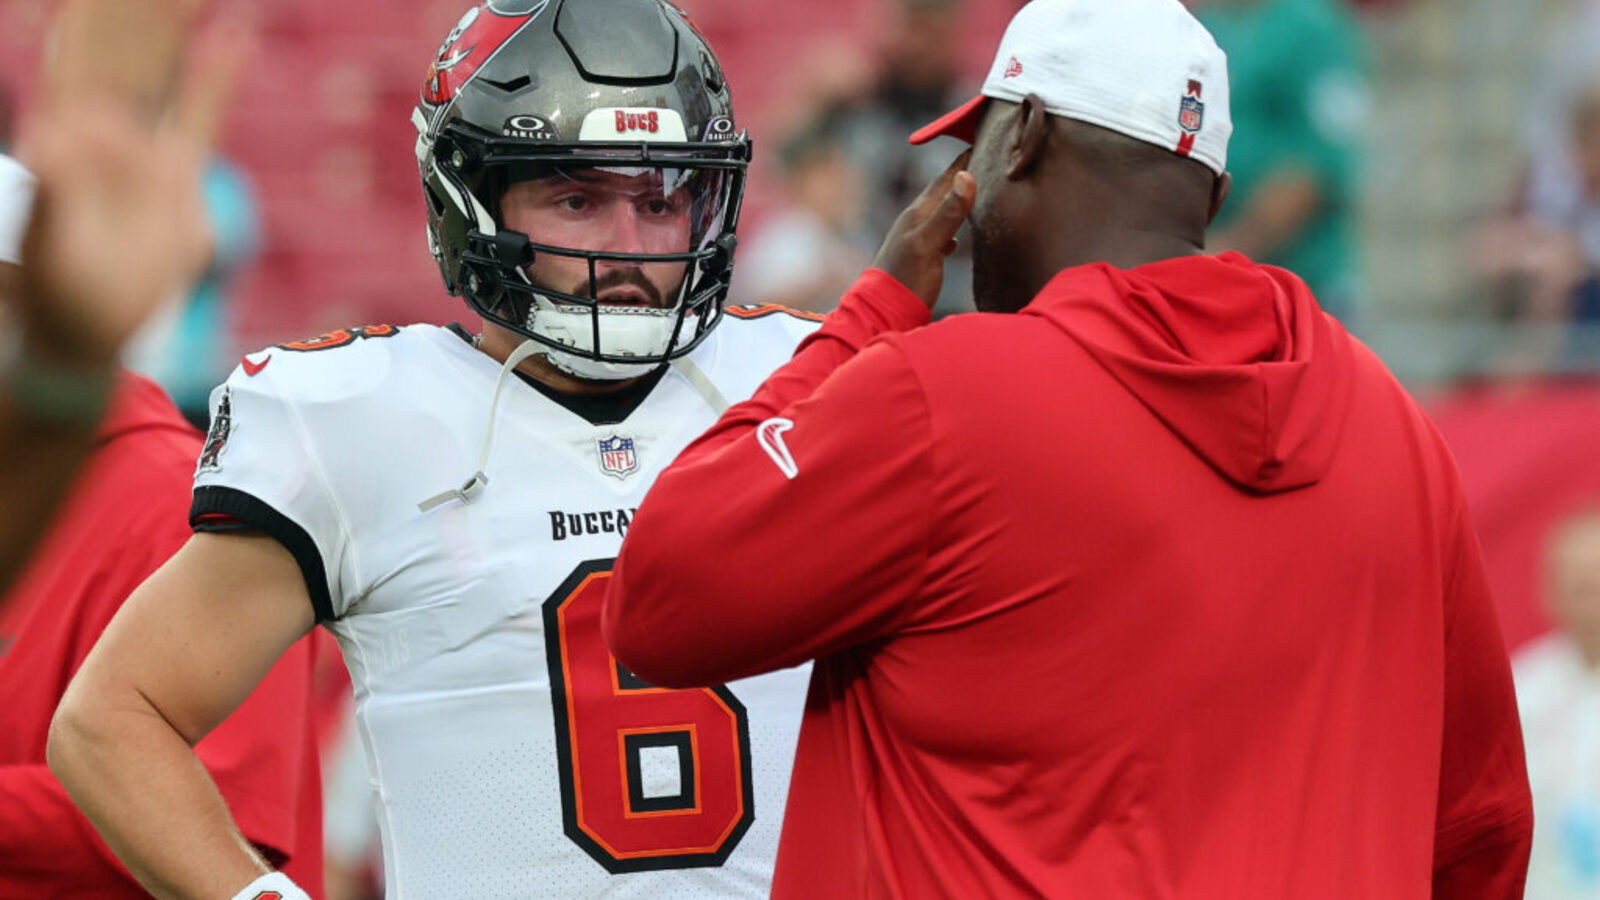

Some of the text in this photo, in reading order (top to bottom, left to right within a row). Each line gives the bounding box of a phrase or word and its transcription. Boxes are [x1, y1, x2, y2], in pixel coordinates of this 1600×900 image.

[503, 129, 552, 140] OAKLEY
[604, 450, 634, 470] NFL
[547, 508, 637, 541] BUCCA
[541, 556, 755, 875] 6
